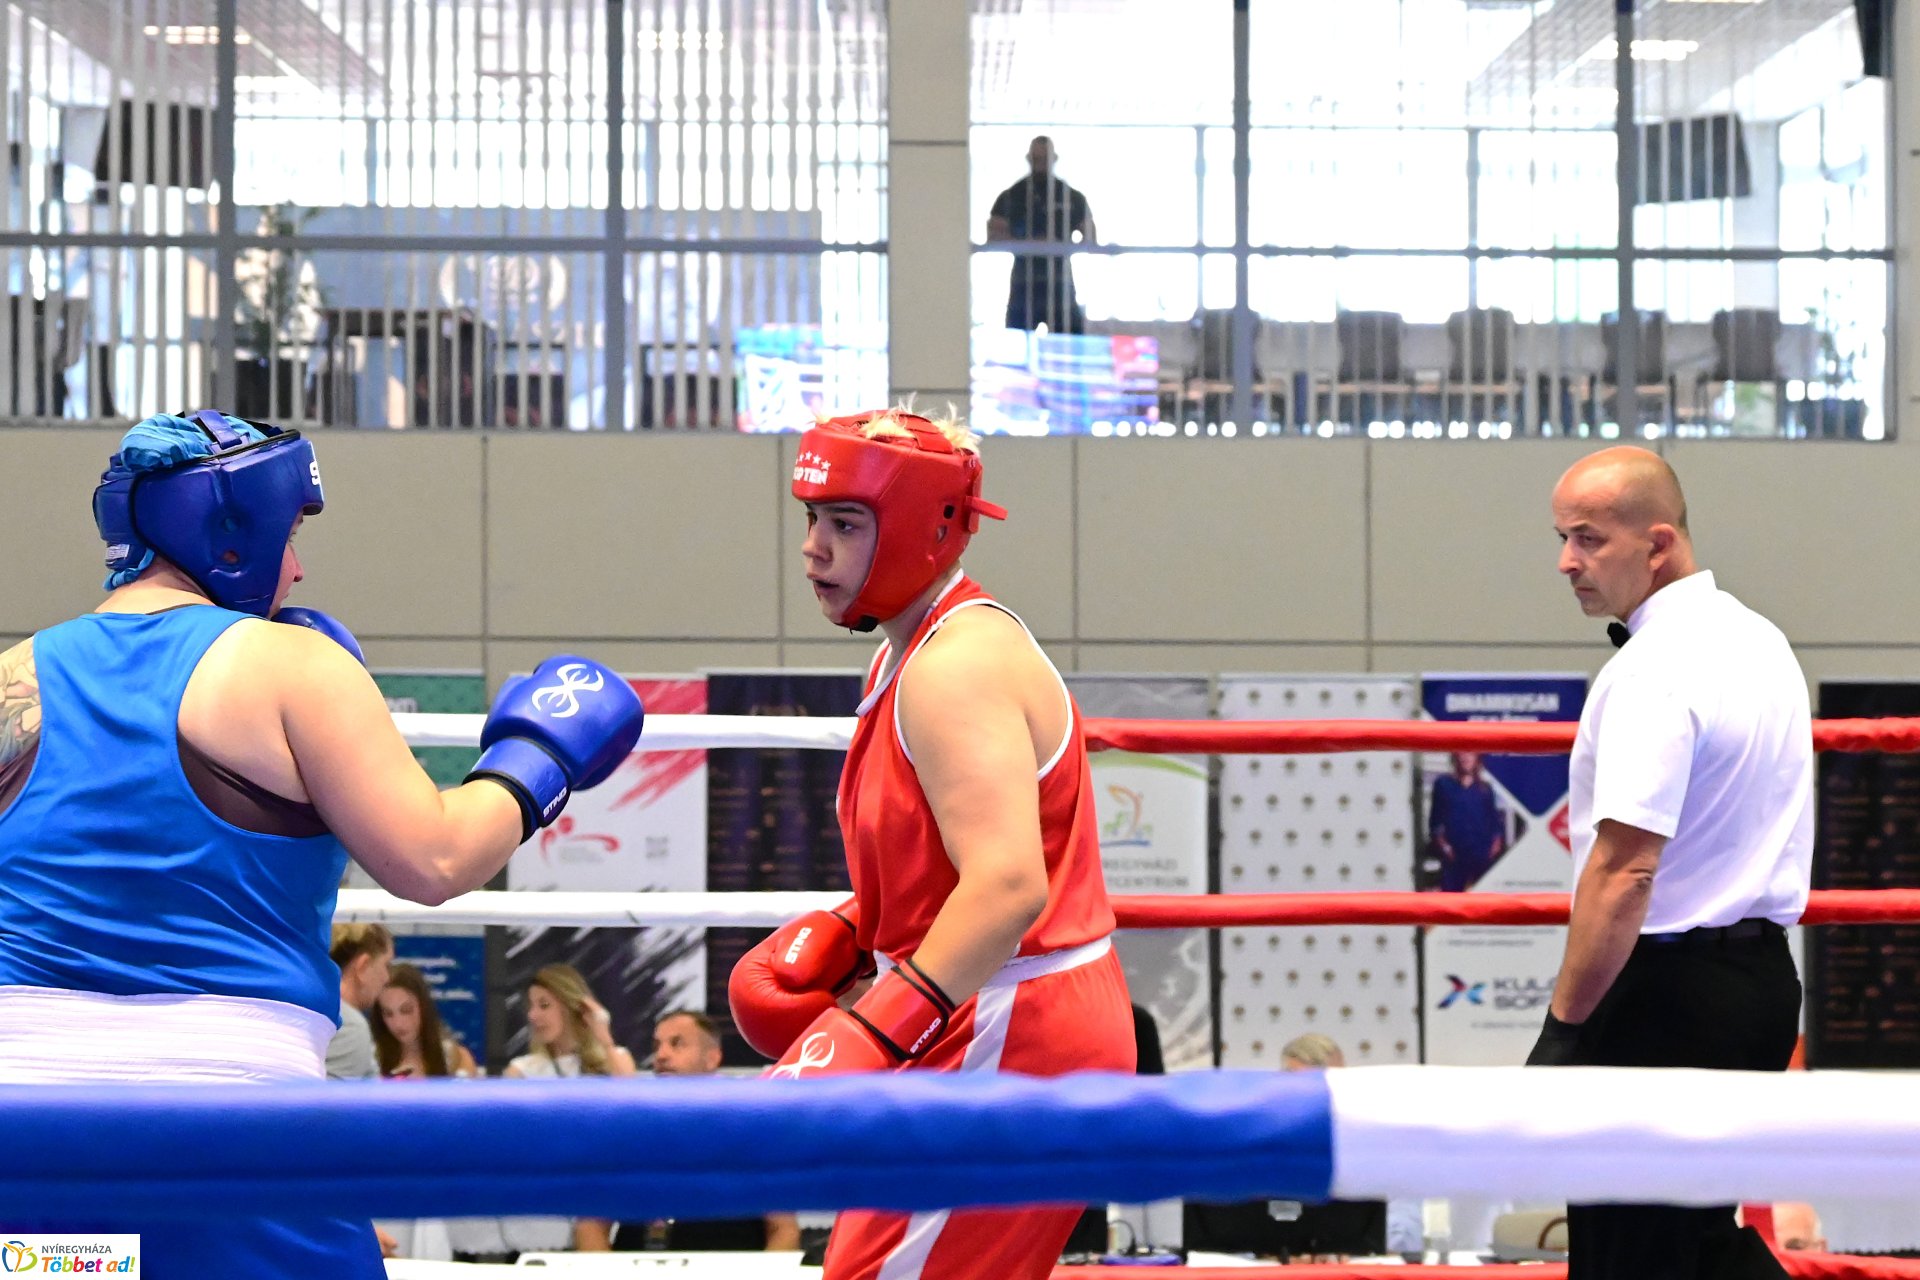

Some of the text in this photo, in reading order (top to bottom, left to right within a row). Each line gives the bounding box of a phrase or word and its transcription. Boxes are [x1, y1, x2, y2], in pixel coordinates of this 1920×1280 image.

[309, 460, 320, 485] S
[804, 467, 828, 485] TEN
[1444, 692, 1560, 713] DINAMIKUSAN
[543, 786, 567, 818] STING
[1102, 857, 1178, 870] REGYHÁZI
[1107, 875, 1189, 887] TCENTRUM
[784, 927, 813, 964] STING
[1494, 994, 1552, 1010] SOF
[910, 1017, 941, 1054] STING
